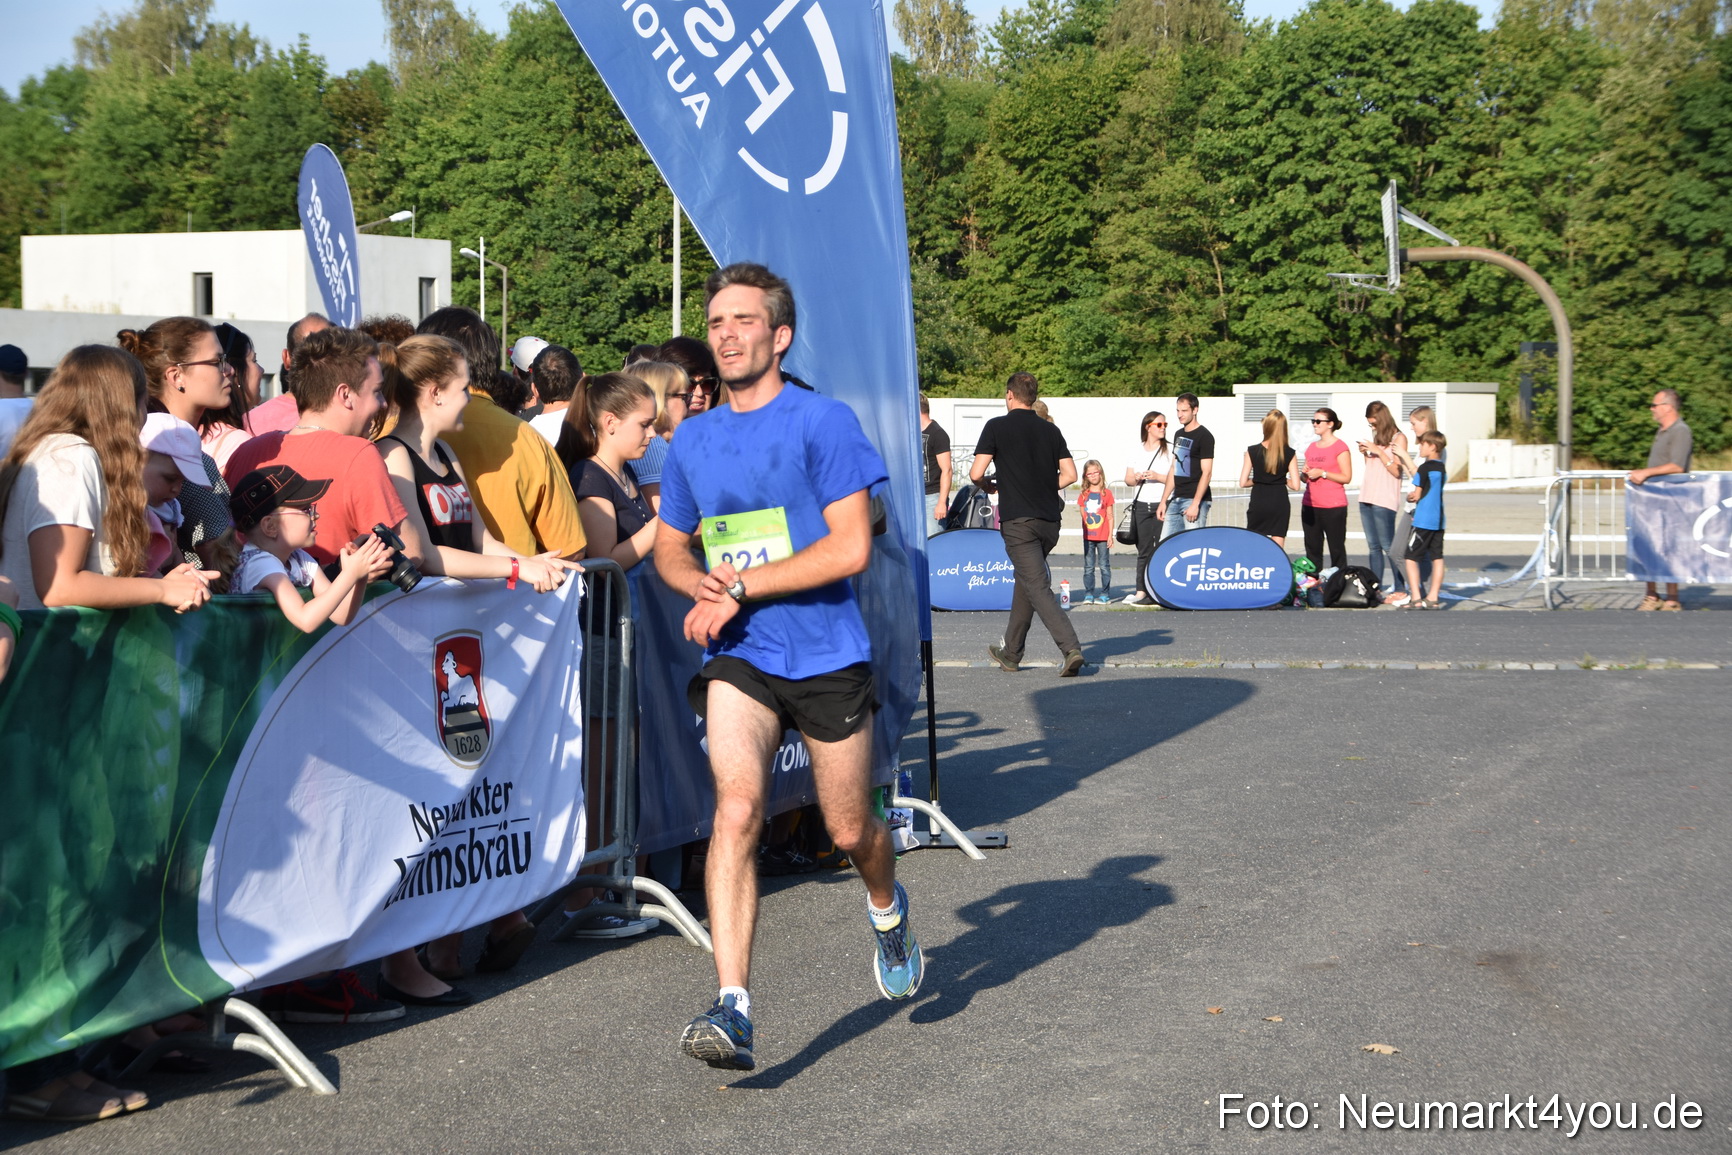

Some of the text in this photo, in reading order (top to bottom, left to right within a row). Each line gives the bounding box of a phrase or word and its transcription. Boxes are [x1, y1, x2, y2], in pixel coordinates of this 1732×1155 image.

[963, 561, 984, 572] das
[986, 560, 1015, 573] Läche
[1186, 562, 1275, 582] Fischer
[968, 575, 999, 590] fährt
[1195, 582, 1270, 591] AUTOMOBILE
[454, 734, 481, 756] 1628
